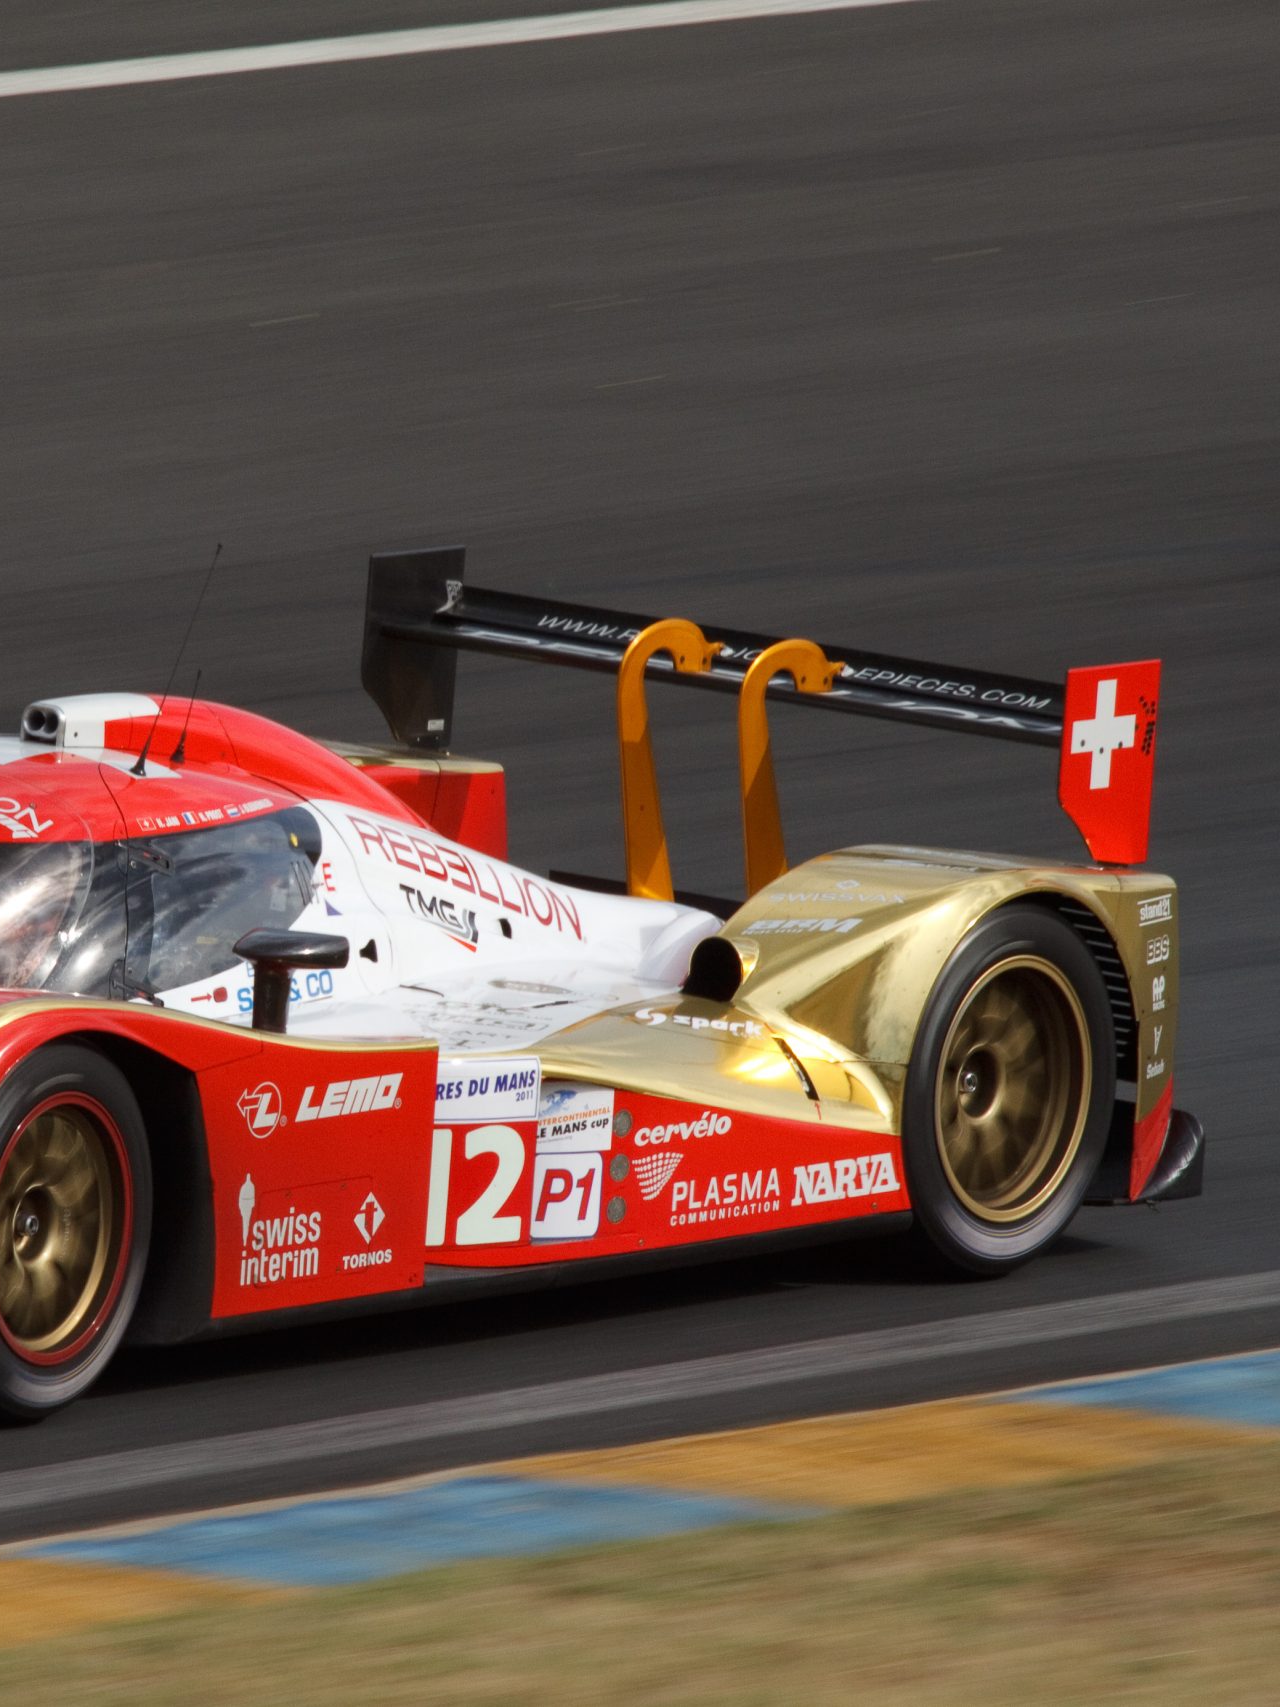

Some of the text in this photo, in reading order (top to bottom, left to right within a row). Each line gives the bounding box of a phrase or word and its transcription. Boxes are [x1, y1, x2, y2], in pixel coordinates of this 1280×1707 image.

[346, 814, 582, 941] REBELLION
[399, 883, 464, 930] TMG
[1146, 934, 1170, 965] BBS
[306, 970, 333, 997] CO
[295, 1072, 404, 1123] LEMO
[436, 1069, 536, 1101] RES DU MANS
[516, 1090, 534, 1103] 2011
[538, 1106, 611, 1126] NTERCONTINENTAL
[551, 1120, 588, 1136] MANS
[590, 1117, 610, 1129] cup
[634, 1110, 732, 1147] cervélo
[425, 1124, 526, 1247] 12
[535, 1167, 596, 1222] P1
[671, 1167, 781, 1212] PLASMA
[791, 1152, 900, 1207] NARVA
[251, 1206, 322, 1251] swiss
[670, 1200, 780, 1227] COMMUNICATION
[240, 1247, 319, 1286] interim
[342, 1248, 393, 1270] TORNOS
